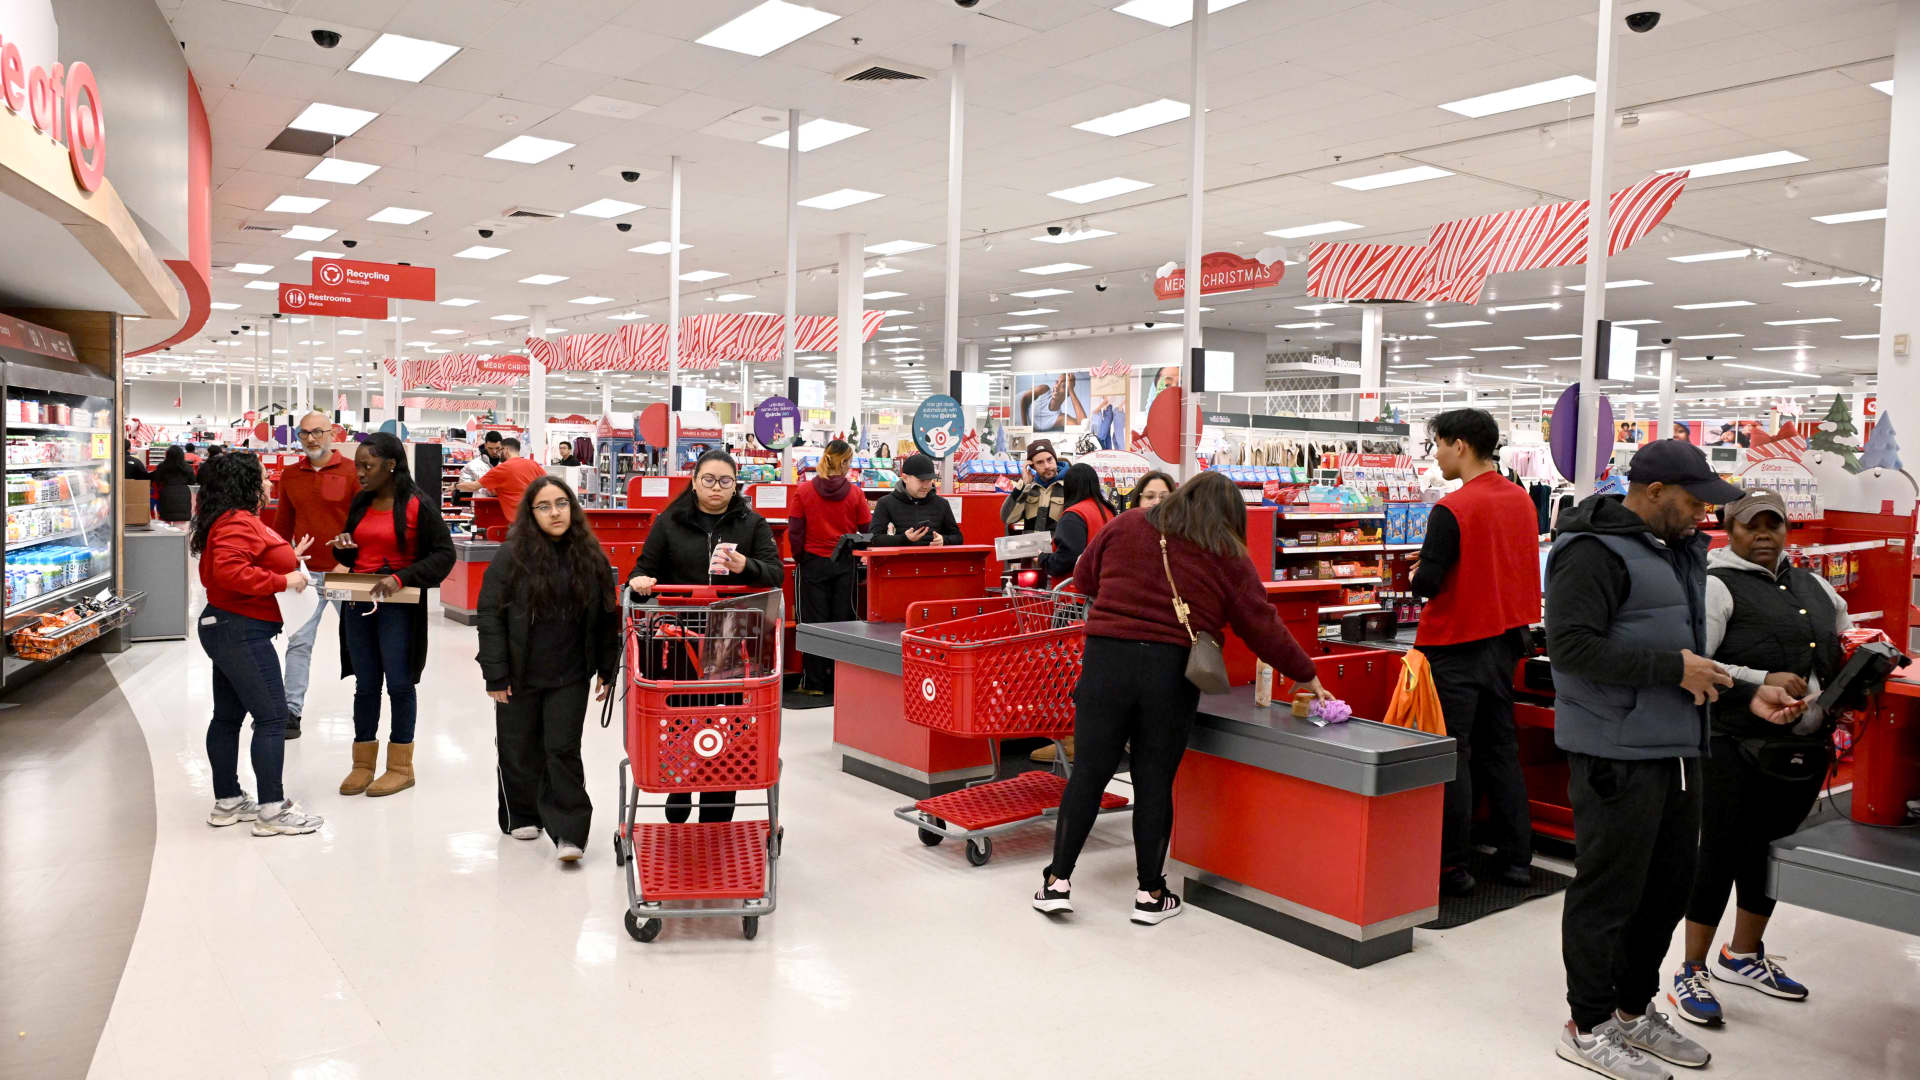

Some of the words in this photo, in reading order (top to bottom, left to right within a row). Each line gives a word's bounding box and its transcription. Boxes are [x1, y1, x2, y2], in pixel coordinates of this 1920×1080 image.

[0, 34, 25, 112] e
[29, 62, 65, 142] of
[346, 268, 391, 282] Recycling
[1164, 278, 1186, 292] MER
[1202, 265, 1272, 287] CHRISTMAS
[308, 292, 352, 303] Restrooms
[507, 363, 530, 371] CHRIST
